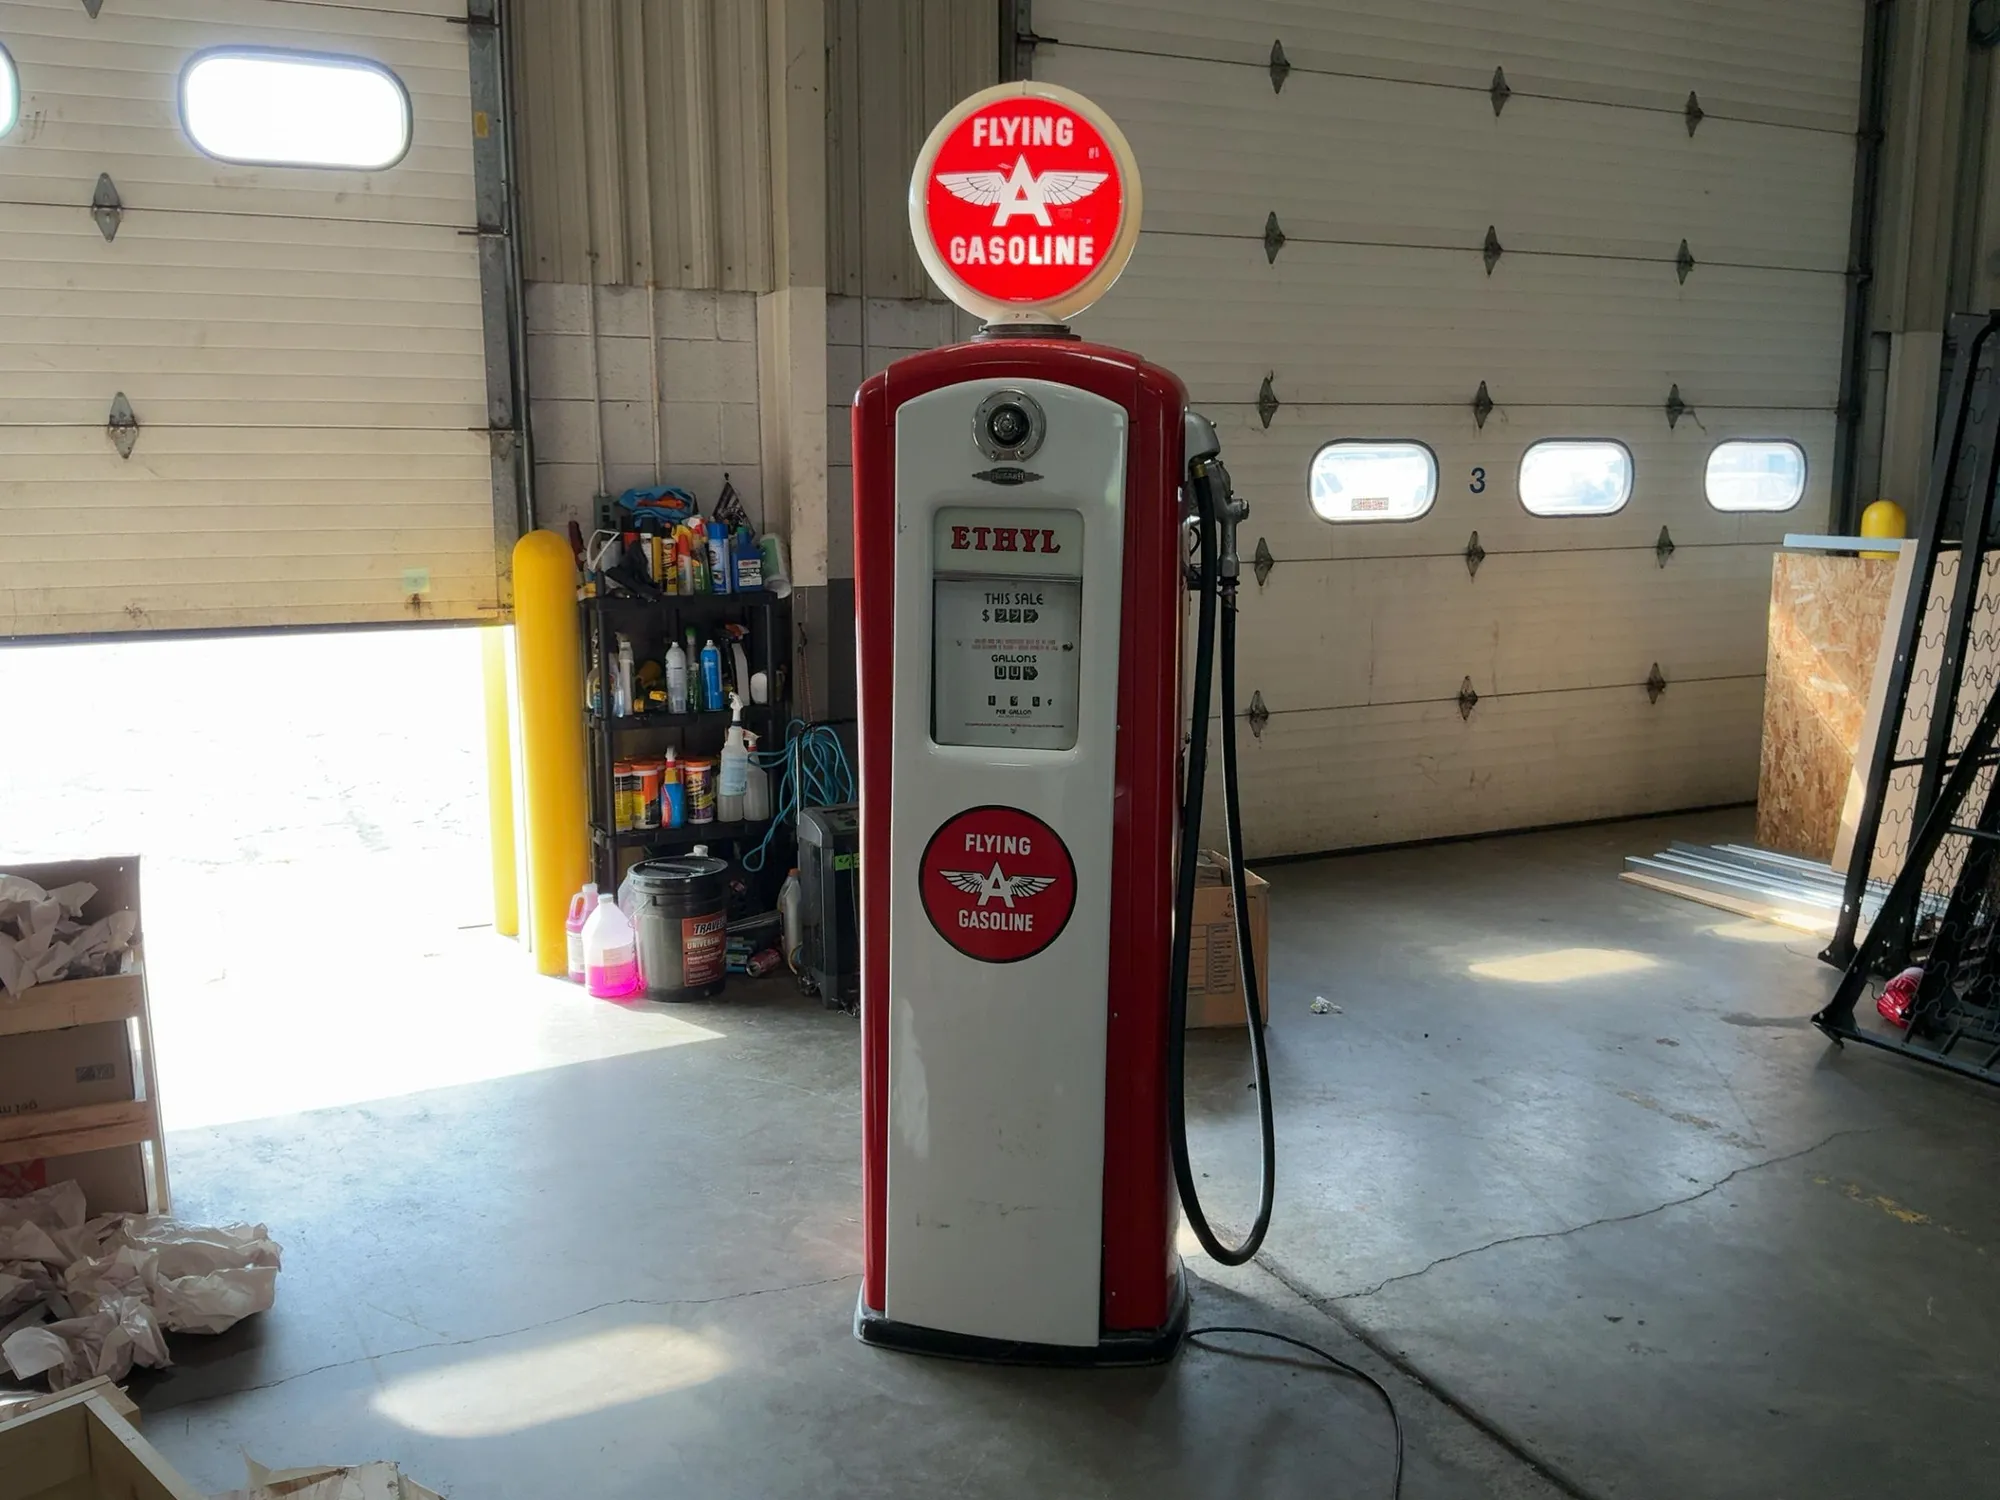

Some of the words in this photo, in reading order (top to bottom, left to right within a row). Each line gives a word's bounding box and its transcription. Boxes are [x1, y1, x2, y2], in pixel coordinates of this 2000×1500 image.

[973, 116, 1073, 147] FLYING
[950, 235, 1094, 265] GASOLINE
[1469, 467, 1486, 494] 3
[951, 526, 1061, 553] ETHYL
[984, 593, 1010, 605] THIS
[1015, 593, 1044, 605] SALE
[982, 609, 990, 622] $
[991, 654, 1037, 663] GALLONS
[965, 833, 1031, 856] FLYING
[958, 909, 1033, 932] GASOLINE
